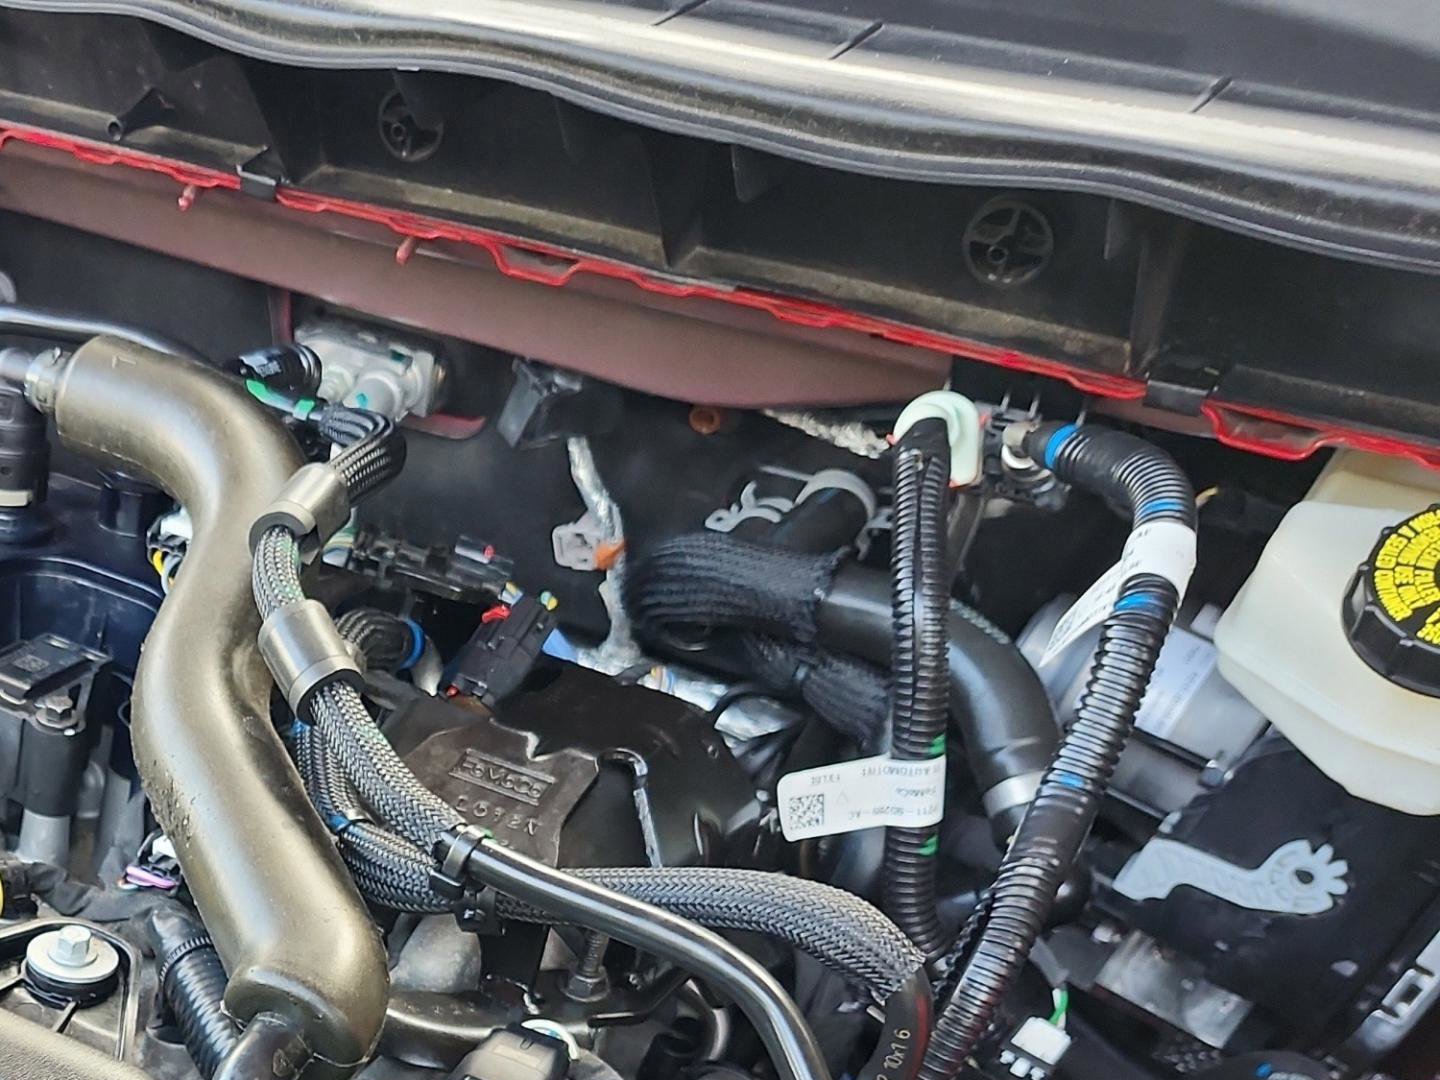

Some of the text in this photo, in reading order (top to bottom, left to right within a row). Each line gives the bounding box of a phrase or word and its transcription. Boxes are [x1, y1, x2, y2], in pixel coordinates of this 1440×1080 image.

[1375, 533, 1409, 569] SEALED
[1394, 565, 1415, 585] USE
[1374, 569, 1413, 622] CONTAINER
